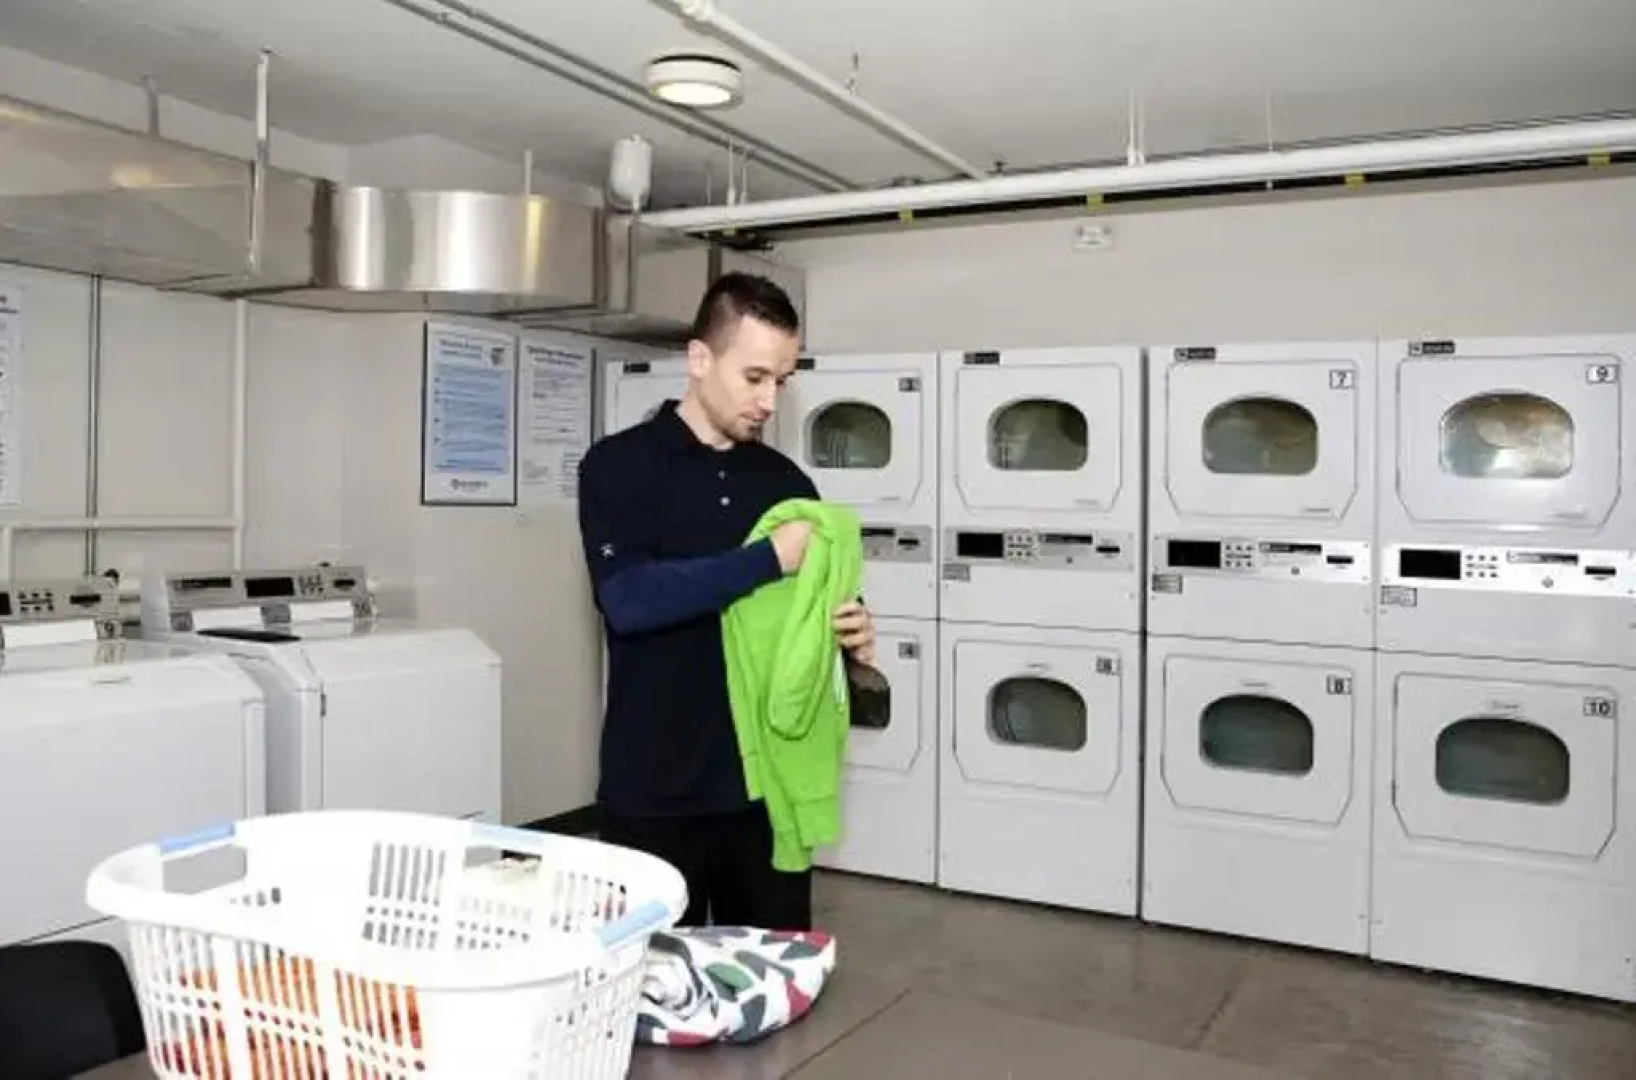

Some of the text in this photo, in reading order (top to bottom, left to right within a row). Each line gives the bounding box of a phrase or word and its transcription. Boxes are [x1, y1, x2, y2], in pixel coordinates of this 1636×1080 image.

[1337, 370, 1347, 386] 7
[1597, 365, 1609, 382] 9
[1589, 700, 1610, 716] 10
